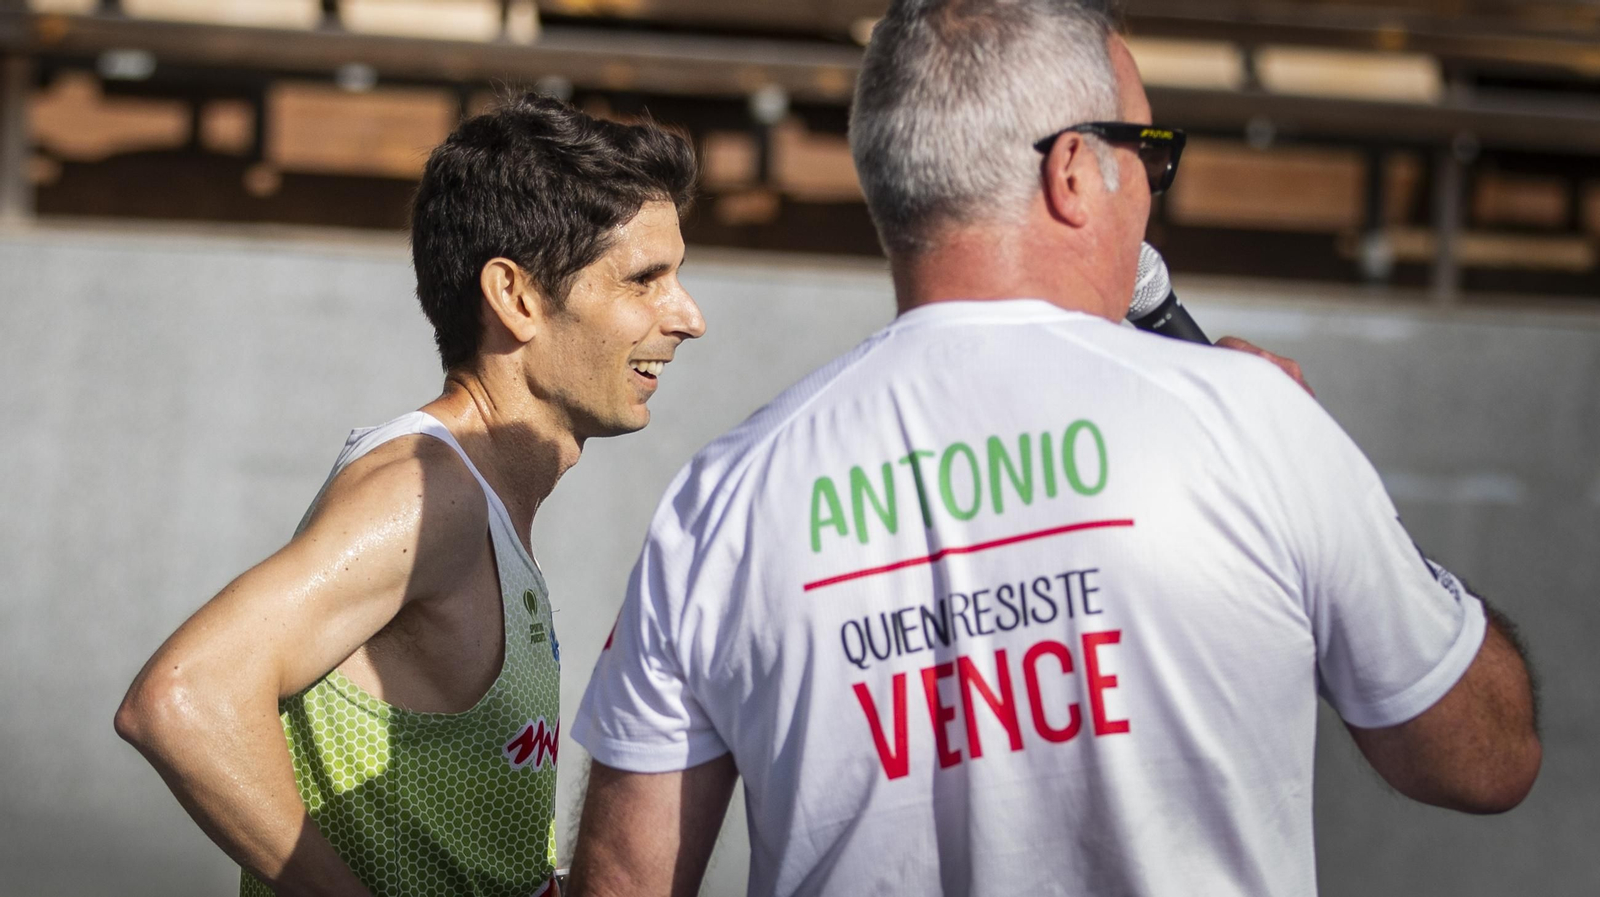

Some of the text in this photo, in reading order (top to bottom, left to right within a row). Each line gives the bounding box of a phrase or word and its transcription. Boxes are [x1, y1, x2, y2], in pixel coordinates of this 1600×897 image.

[810, 419, 1108, 553] ANTONIO
[840, 568, 1104, 670] QUIEN RESISTE
[852, 629, 1131, 781] VENCE
